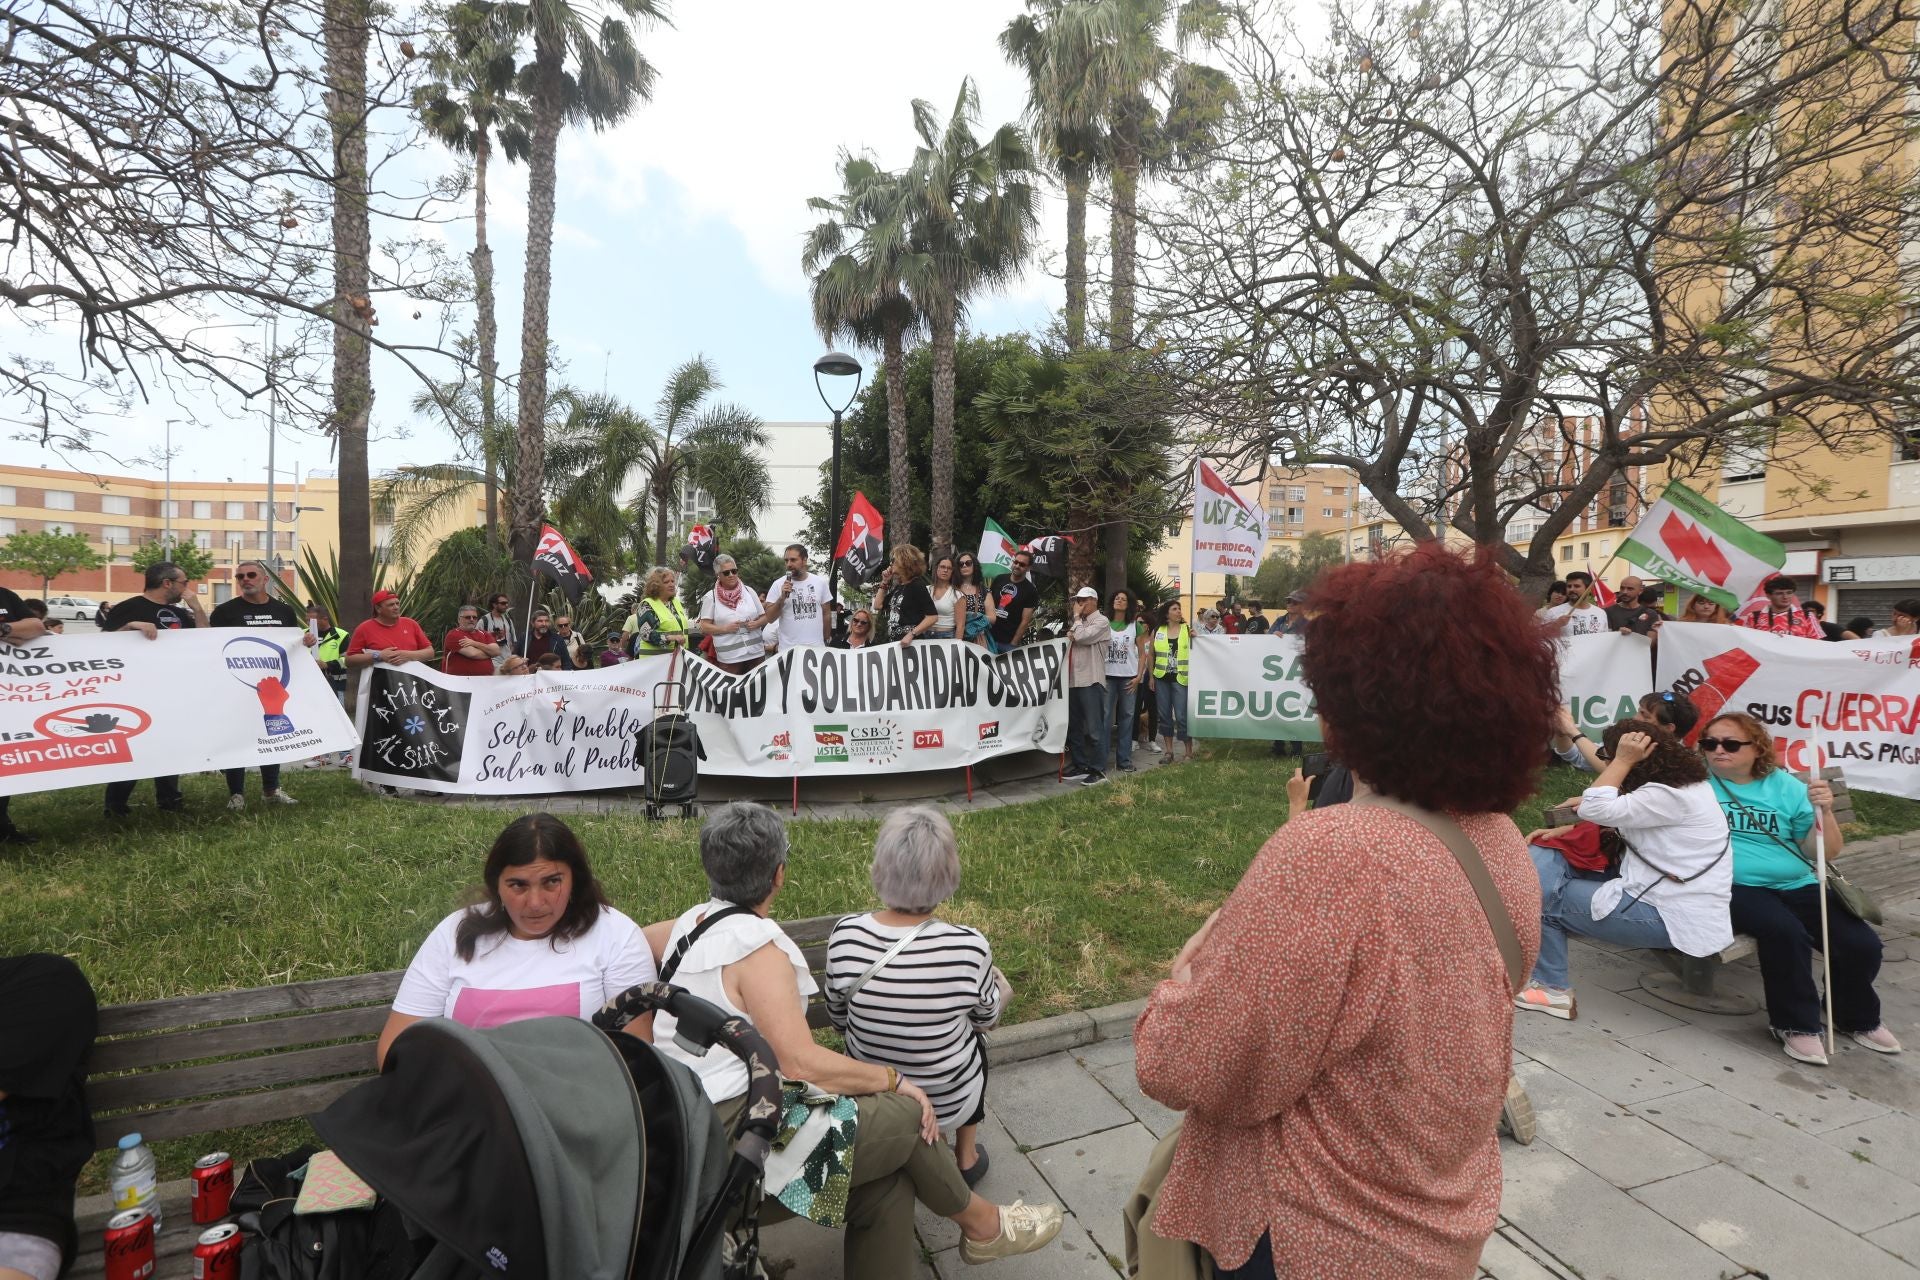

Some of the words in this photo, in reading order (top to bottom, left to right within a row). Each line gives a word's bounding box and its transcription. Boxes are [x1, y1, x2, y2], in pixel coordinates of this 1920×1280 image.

[1203, 498, 1263, 541] USTEA
[225, 657, 282, 672] ACERINOX
[1262, 654, 1305, 682] SA
[66, 673, 122, 687] VAN
[777, 648, 795, 715] Y
[801, 643, 980, 714] SOLIDARIDAD
[980, 641, 1068, 709] OBRERA
[608, 684, 647, 698] BARRIOS
[1746, 702, 1793, 726] SUS
[1, 731, 35, 742] la
[257, 728, 314, 745] SINDICALISMO
[488, 718, 539, 749] Solo
[545, 715, 565, 746] el
[572, 707, 643, 742] Pueblo
[981, 725, 997, 736] CNT
[773, 730, 791, 747] sat
[915, 734, 941, 745] CTA
[0, 738, 118, 766] sindical
[817, 746, 848, 756] USTEA
[1827, 741, 1874, 761] LAS
[476, 751, 548, 782] Salva
[554, 747, 577, 778] al
[583, 739, 641, 774] Puebl
